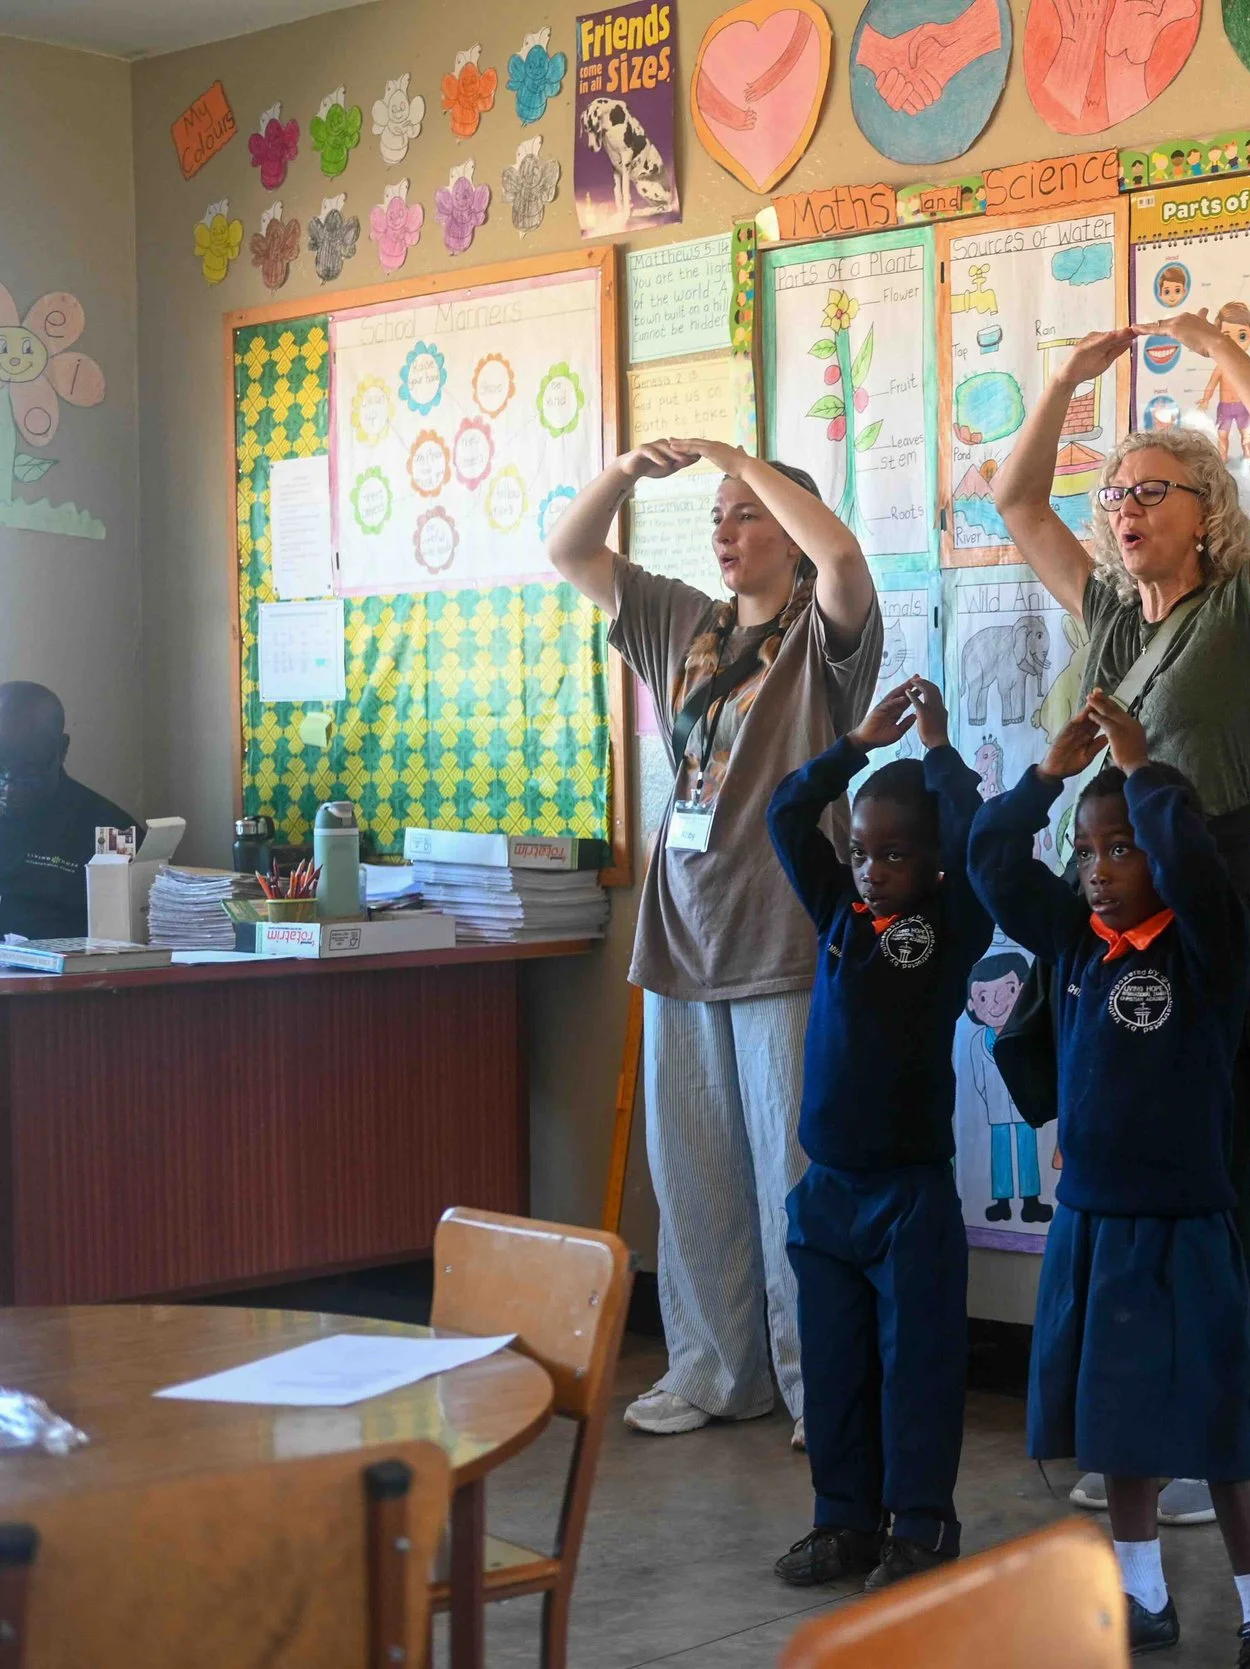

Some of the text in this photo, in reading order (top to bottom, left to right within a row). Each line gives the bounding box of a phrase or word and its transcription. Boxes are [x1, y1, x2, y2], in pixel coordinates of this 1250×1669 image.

[581, 4, 670, 62] Friends
[580, 64, 602, 78] come
[606, 46, 671, 94] sizes
[580, 76, 602, 94] in all
[183, 100, 213, 136] My
[183, 110, 235, 173] Colours
[792, 152, 1119, 237] Maths and Science
[1163, 200, 1221, 221] Parts
[1226, 191, 1249, 209] of
[952, 219, 1112, 260] Sources of Water
[656, 270, 673, 285] are
[679, 266, 699, 280] the
[707, 261, 733, 284] light
[779, 250, 919, 289] Parts of a Plant
[633, 293, 644, 310] of
[650, 293, 669, 307] the
[883, 287, 919, 302] Flower
[44, 310, 66, 338] e
[634, 310, 661, 326] town
[665, 305, 686, 320] built
[689, 304, 700, 315] on
[713, 298, 730, 313] hill
[671, 324, 685, 336] be
[1035, 320, 1056, 337] Rain
[952, 344, 968, 360] Tap
[889, 373, 918, 394] Fruit
[659, 393, 679, 414] put
[685, 390, 700, 403] us
[635, 418, 667, 433] earth
[695, 409, 728, 423] take
[891, 434, 924, 448] Leaves
[953, 448, 972, 461] Pond
[890, 505, 924, 520] Roots
[956, 527, 981, 546] River
[884, 592, 921, 617] imals
[964, 585, 1000, 611] Wild
[267, 929, 314, 944] rotatrim
